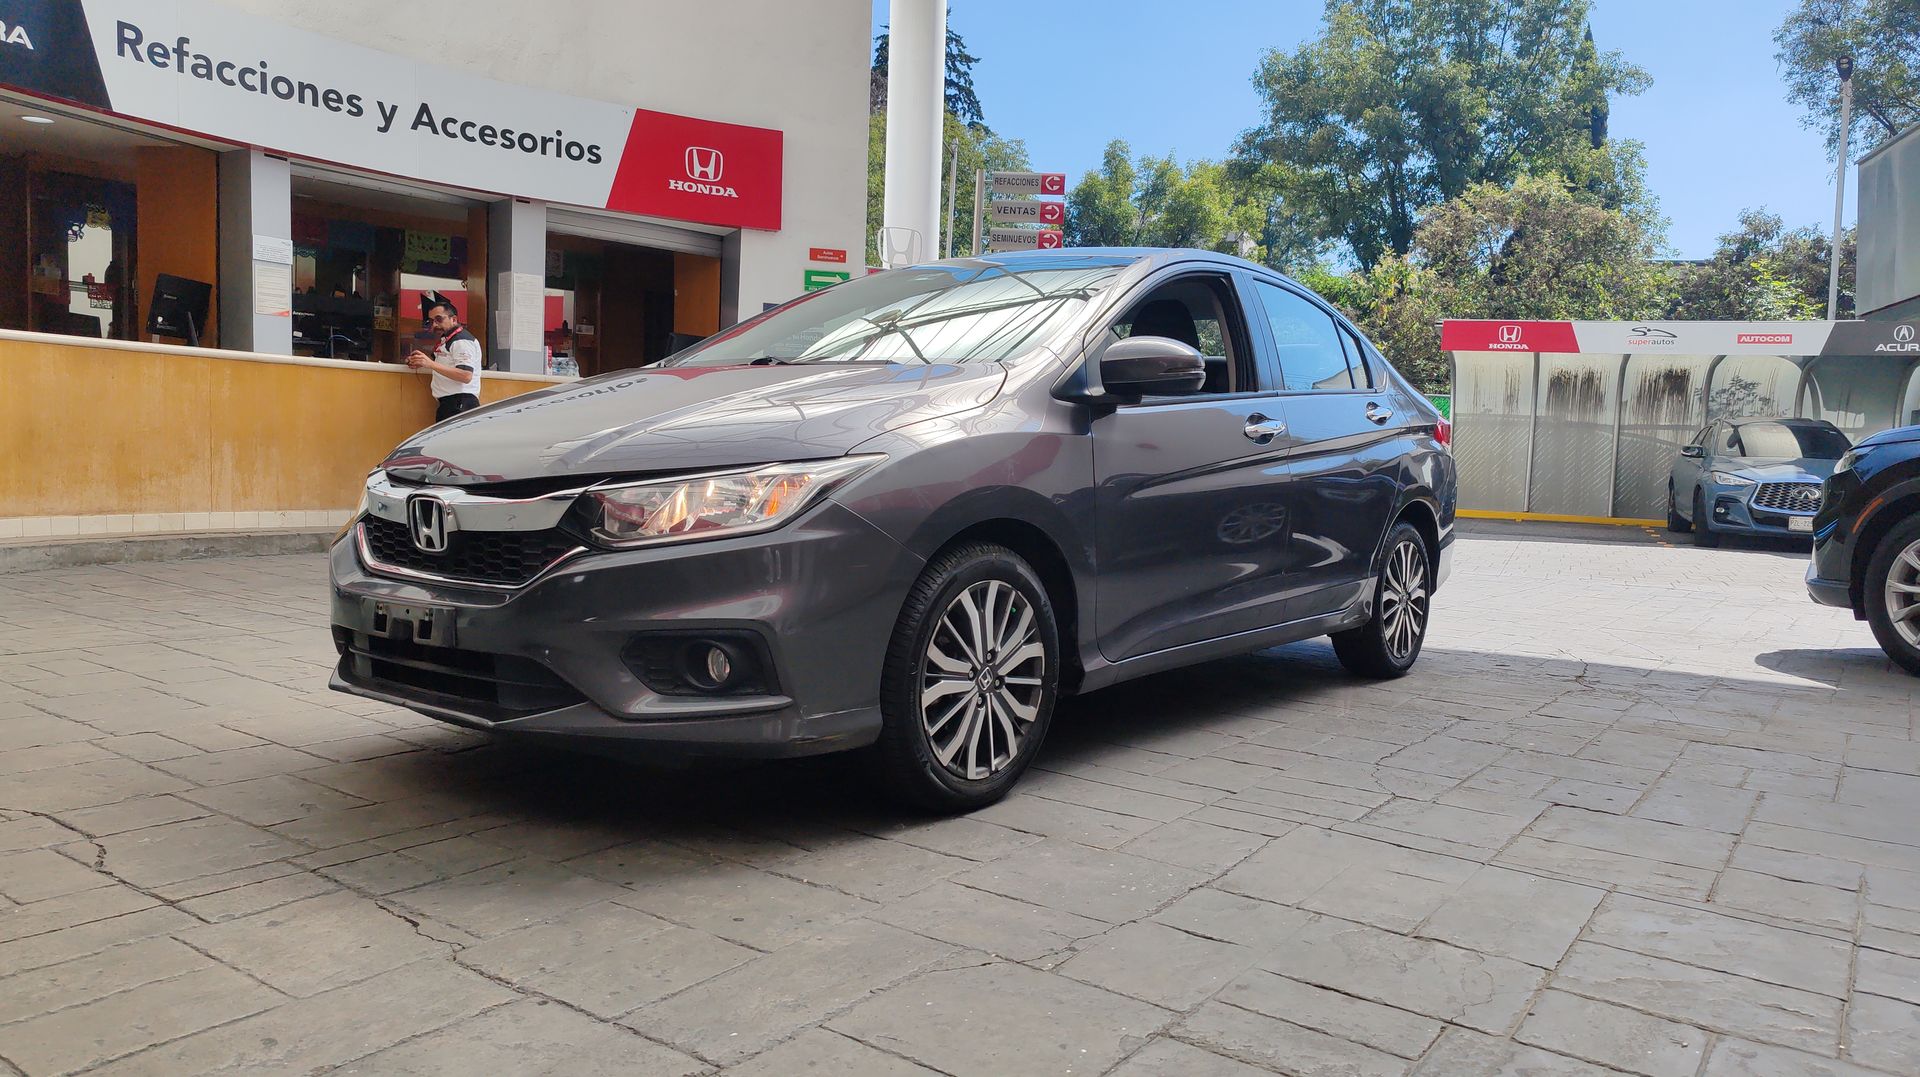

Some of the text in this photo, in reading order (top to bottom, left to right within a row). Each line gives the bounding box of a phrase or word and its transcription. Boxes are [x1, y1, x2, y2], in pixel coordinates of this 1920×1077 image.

[116, 20, 603, 165] Refacciones y Accesorios
[994, 178, 1039, 187] REFACCIONES
[669, 180, 738, 198] HONDA
[997, 206, 1036, 215] VENTAS
[992, 234, 1036, 243] SEMINUEVOS
[1628, 338, 1674, 346] superautos
[1874, 343, 1920, 352] ACUR
